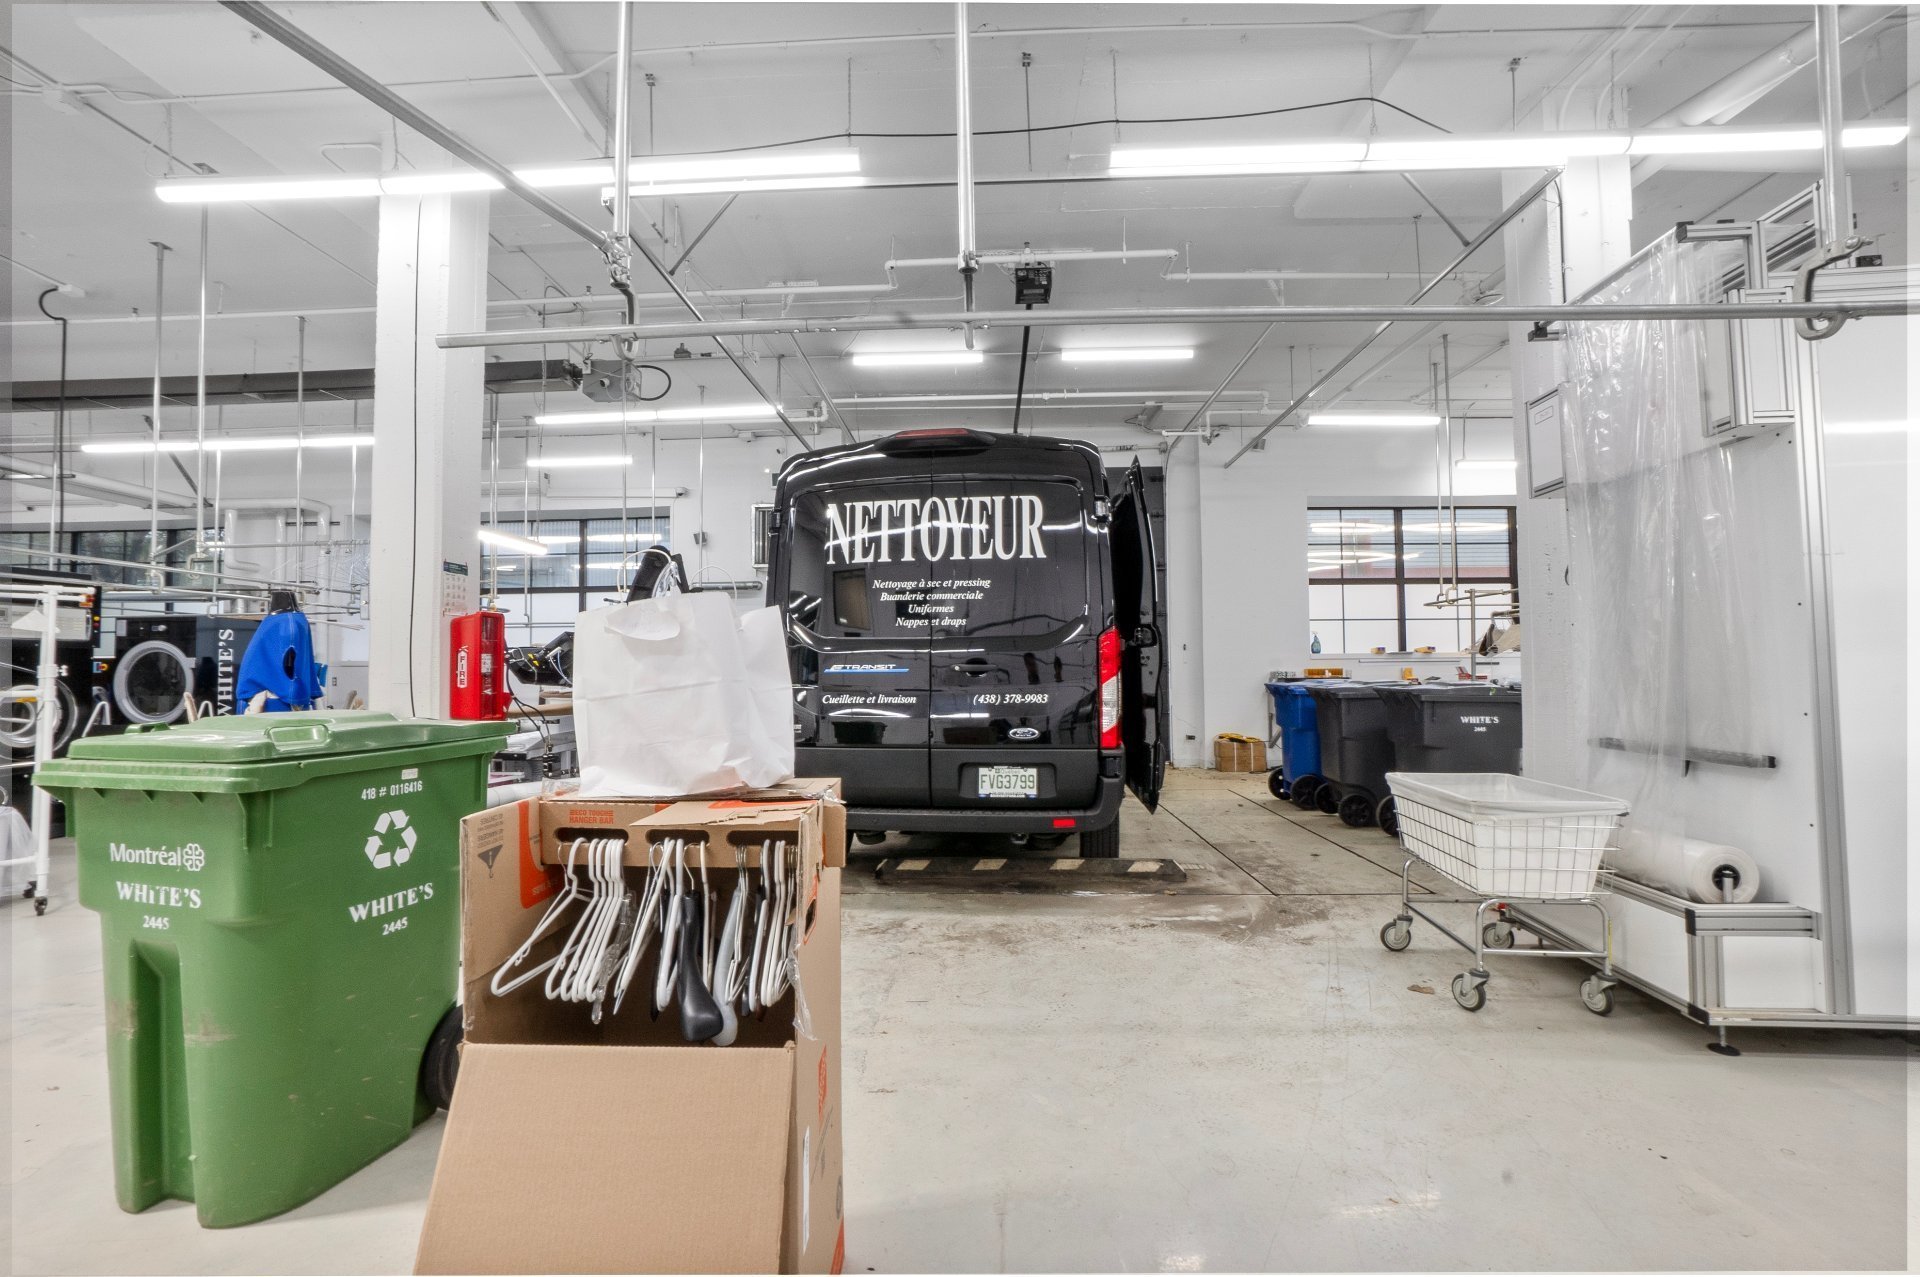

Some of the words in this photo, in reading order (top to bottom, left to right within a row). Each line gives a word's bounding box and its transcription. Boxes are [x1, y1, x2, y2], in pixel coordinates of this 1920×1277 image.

[826, 495, 1047, 565] NETTOYEUR
[872, 579, 917, 591] Nettoyage
[918, 578, 925, 588] à
[926, 580, 941, 588] sec
[942, 579, 952, 588] et
[953, 578, 992, 589] pressing
[880, 592, 925, 602] Buanderie
[926, 590, 984, 600] commerciale
[907, 603, 955, 615] Uniformes
[895, 617, 929, 628] Nappes
[931, 618, 940, 626] et
[941, 616, 967, 628] draps
[218, 628, 234, 716] WHITE'S
[459, 655, 467, 686] FIRE
[822, 694, 865, 705] Cueillette
[866, 695, 875, 704] et
[877, 693, 917, 704] livraison
[973, 694, 1001, 705] (438)
[1003, 693, 1049, 704] 378-9983
[980, 774, 1035, 790] FVG3799
[361, 787, 376, 801] 418
[379, 786, 387, 797] #
[390, 780, 423, 796] 0116416
[569, 816, 597, 824] HANGER
[599, 816, 614, 825] BAR
[109, 842, 181, 867] Montréal
[116, 880, 202, 909] WHITE'S
[348, 882, 434, 924] WHITE'S
[142, 915, 170, 930] 2445
[382, 916, 409, 936] 2445
